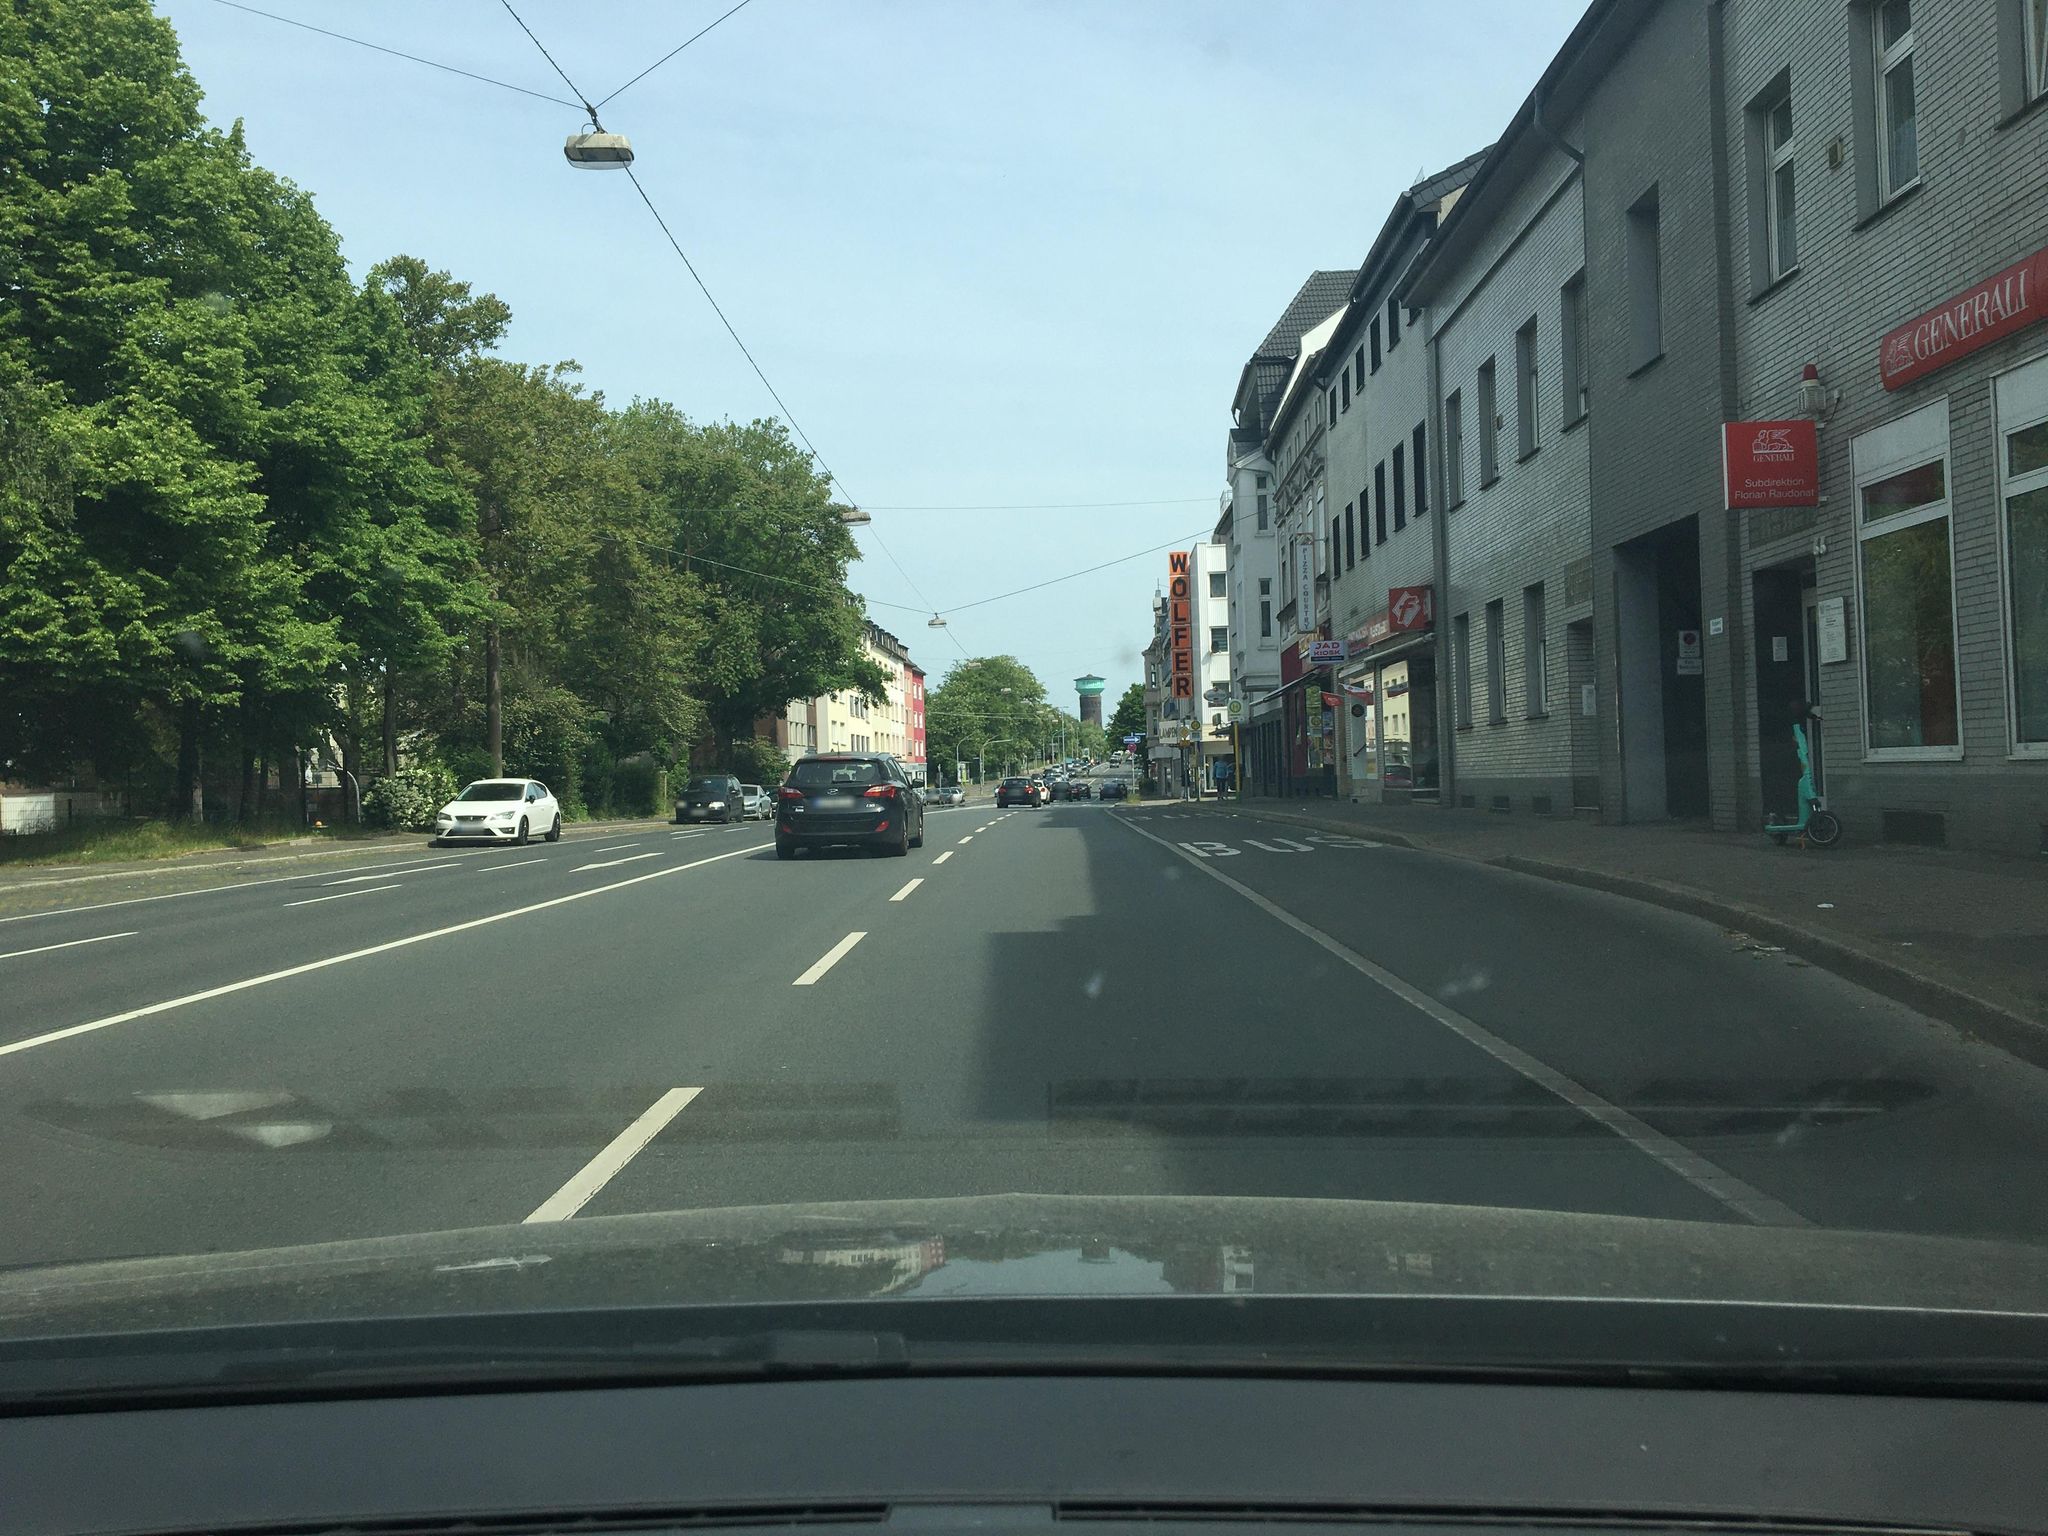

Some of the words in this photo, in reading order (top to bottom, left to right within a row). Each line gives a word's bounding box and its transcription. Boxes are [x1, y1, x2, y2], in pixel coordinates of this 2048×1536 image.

[1914, 268, 2029, 361] GENERALI
[1753, 453, 1795, 462] GENERALI
[1734, 490, 1767, 500] Florian
[1769, 488, 1815, 498] Raudonat
[1744, 478, 1805, 488] Subdirektion
[1302, 583, 1311, 630] COUNTRY
[1170, 554, 1189, 696] WOLFER
[1177, 835, 1383, 857] BUS
